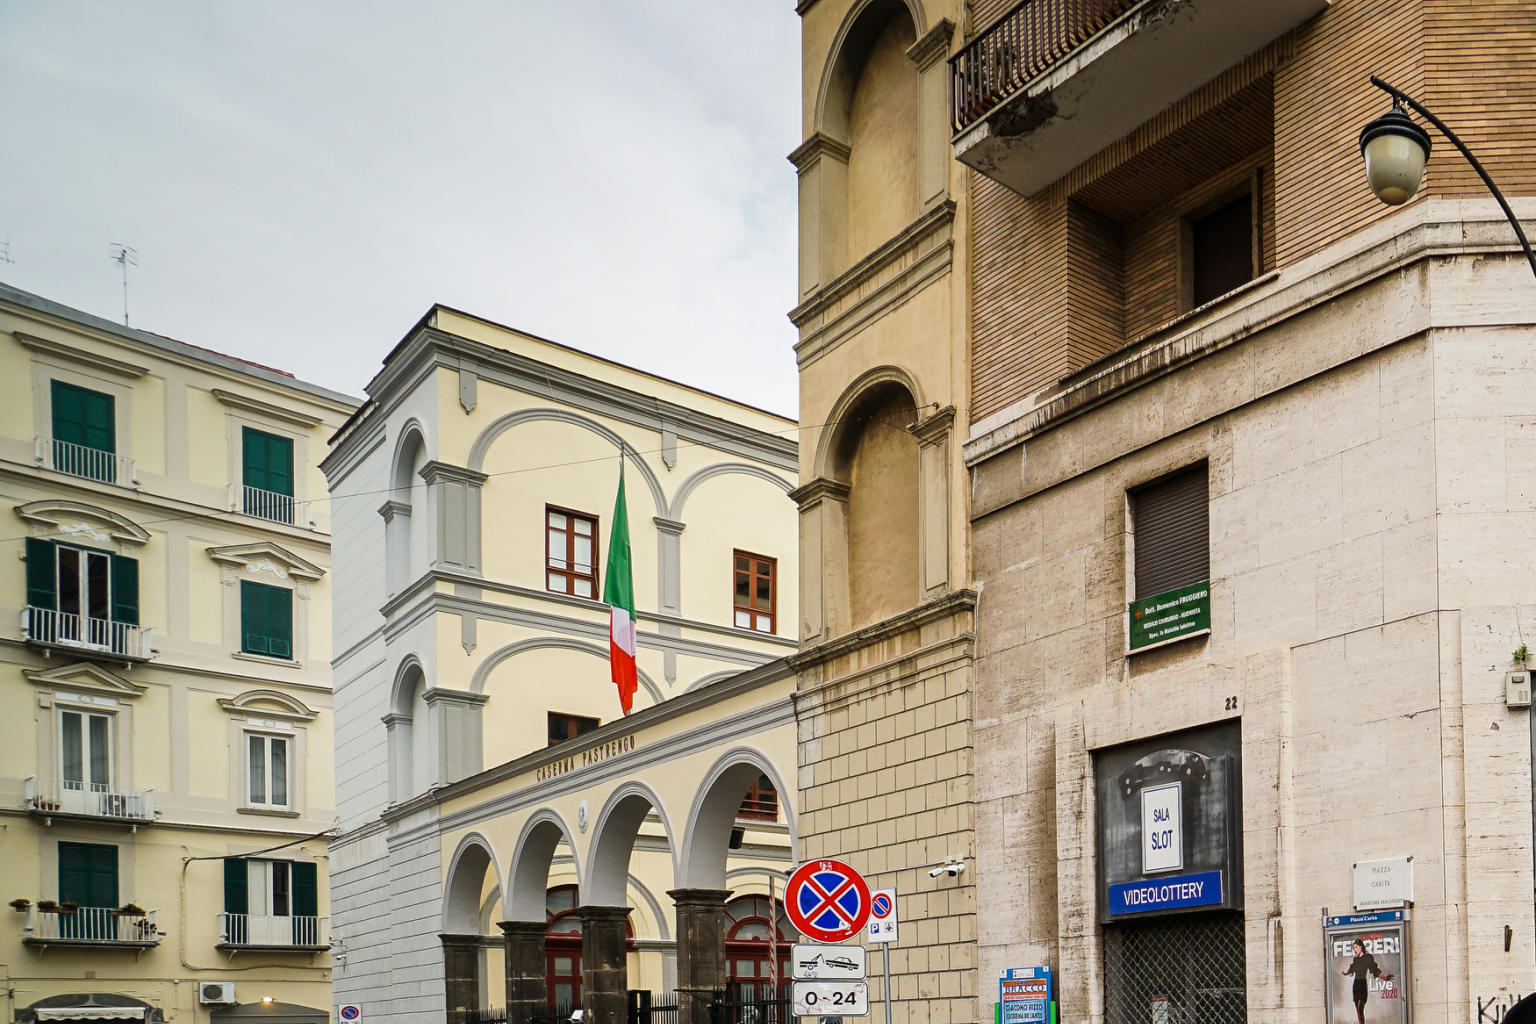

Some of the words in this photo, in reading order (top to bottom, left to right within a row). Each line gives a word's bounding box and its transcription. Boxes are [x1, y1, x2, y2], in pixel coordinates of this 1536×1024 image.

[1157, 600, 1179, 611] Domenico
[1225, 696, 1238, 711] 22
[536, 757, 575, 782] CASERMA
[582, 735, 635, 767] PASTRENGO
[1153, 807, 1170, 822] SALA
[1151, 829, 1173, 850] SLOT
[1123, 881, 1204, 906] VIDEOLOTTERY
[1004, 985, 1044, 993] BRACCO
[1369, 978, 1393, 991] Live
[1381, 989, 1398, 999] 2020
